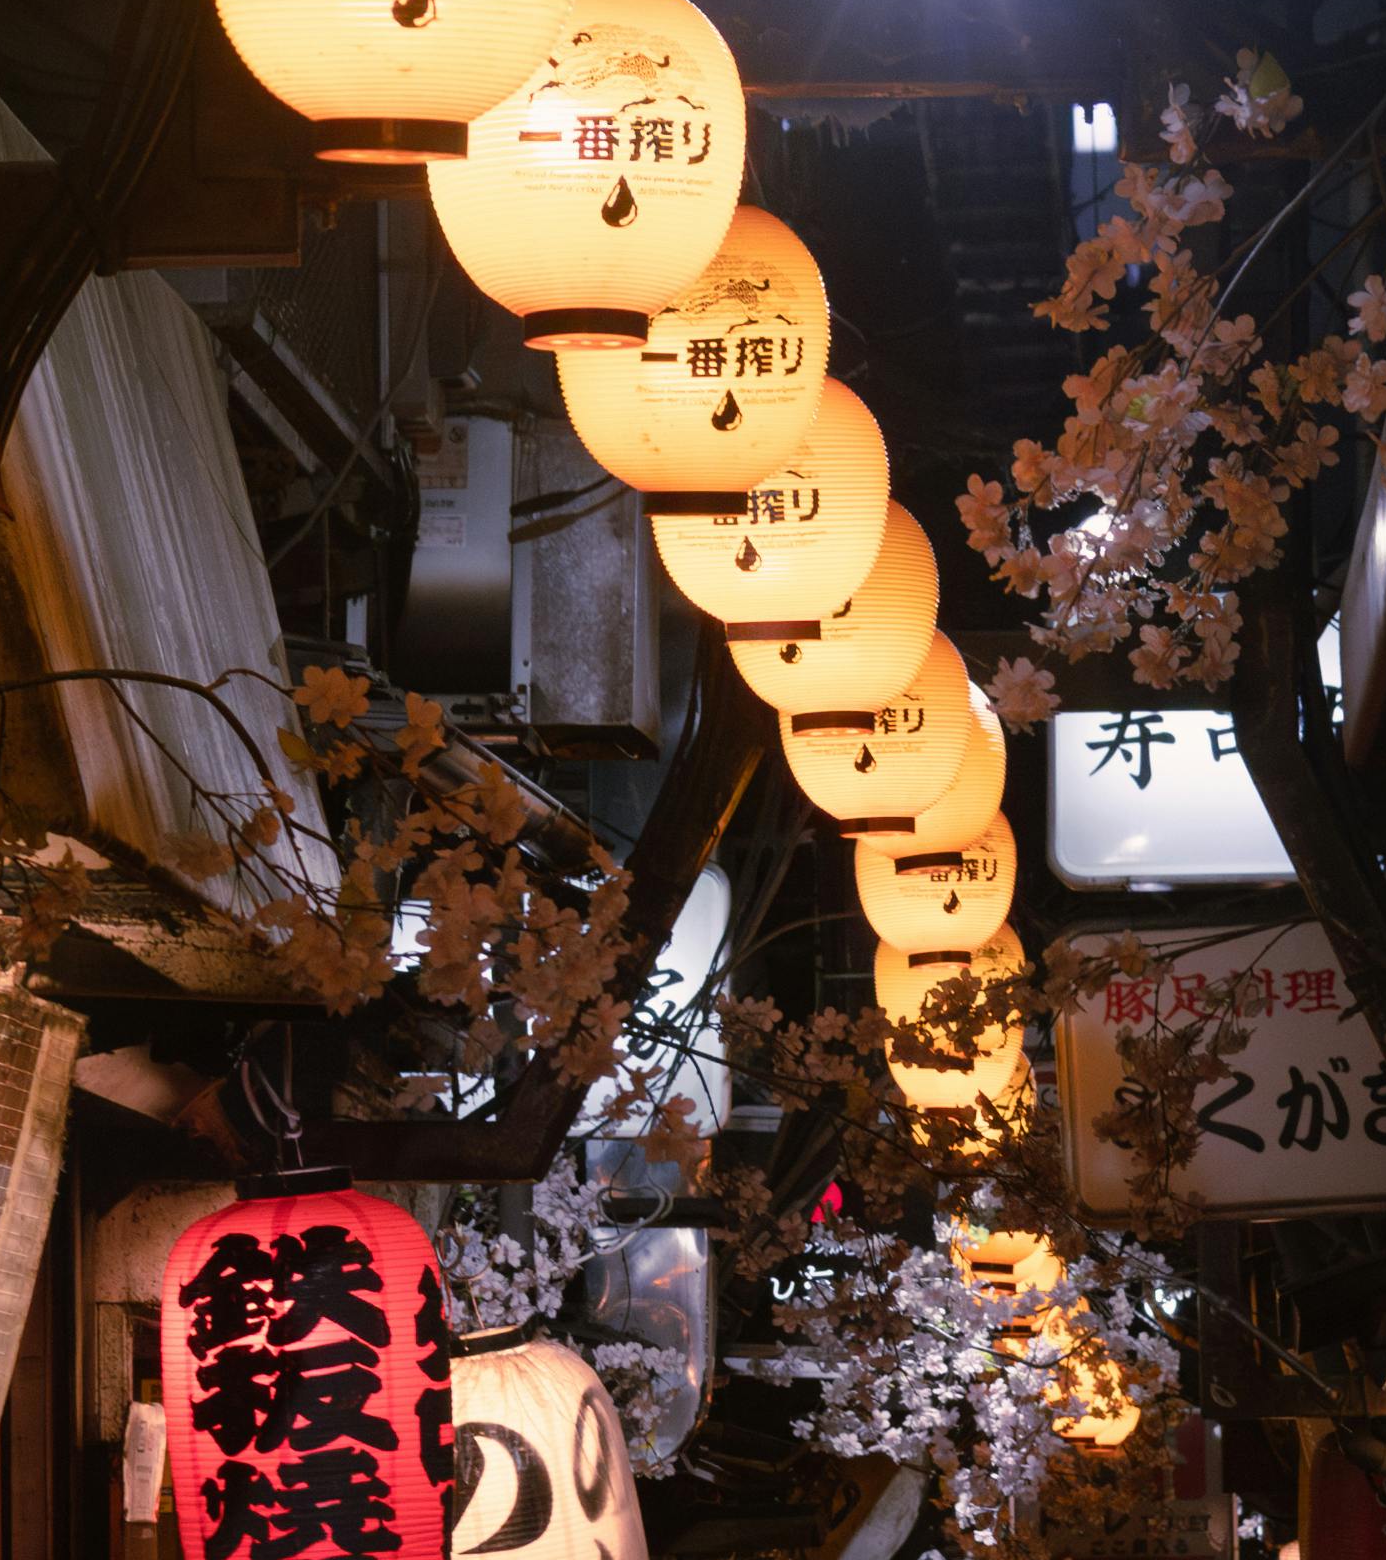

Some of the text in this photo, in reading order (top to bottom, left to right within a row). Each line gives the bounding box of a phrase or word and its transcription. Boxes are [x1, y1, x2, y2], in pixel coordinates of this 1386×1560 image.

[518, 115, 711, 165] 一番搾り
[640, 336, 804, 377] 一番搾り
[714, 489, 819, 525] 搾り
